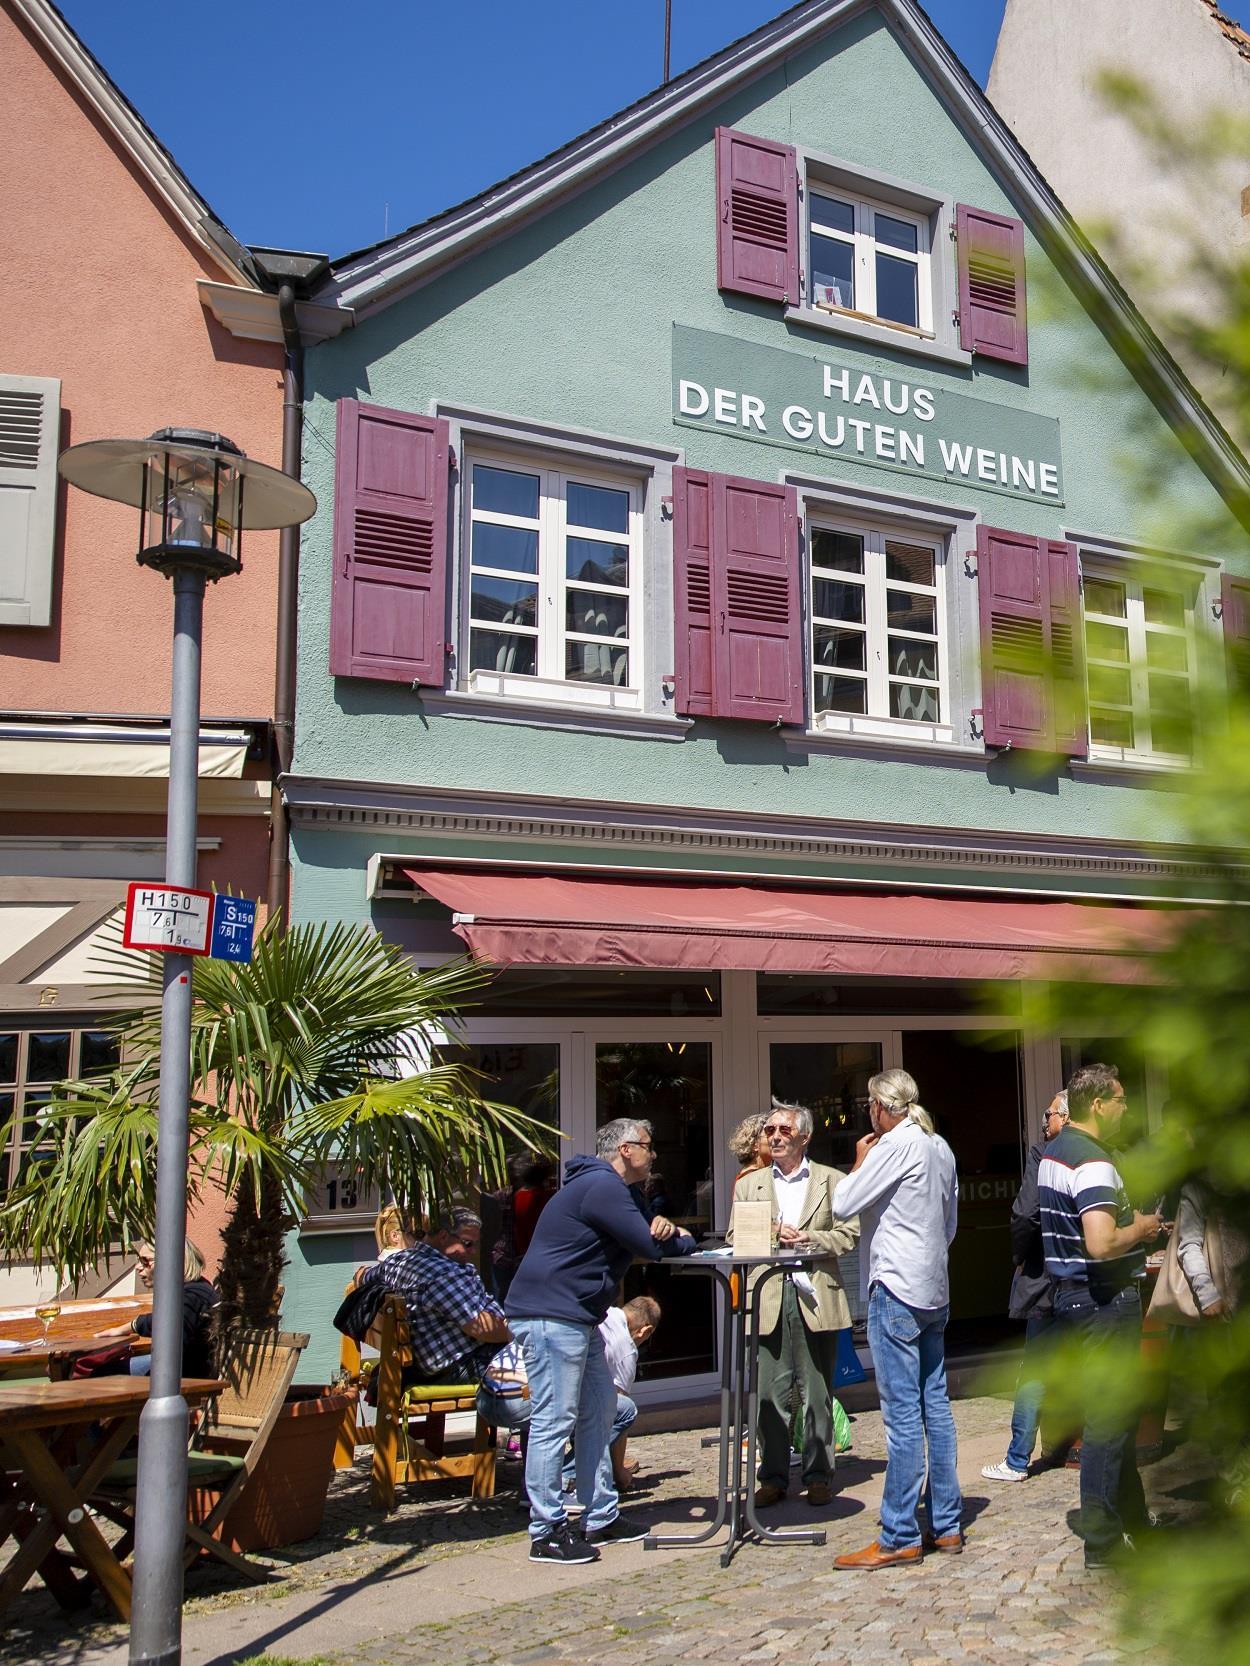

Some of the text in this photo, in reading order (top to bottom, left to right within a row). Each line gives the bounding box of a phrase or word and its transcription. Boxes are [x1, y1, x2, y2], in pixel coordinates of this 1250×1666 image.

[823, 365, 936, 422] HAUS
[679, 379, 1059, 494] DER GUTEN WEINE
[326, 1180, 357, 1210] 13
